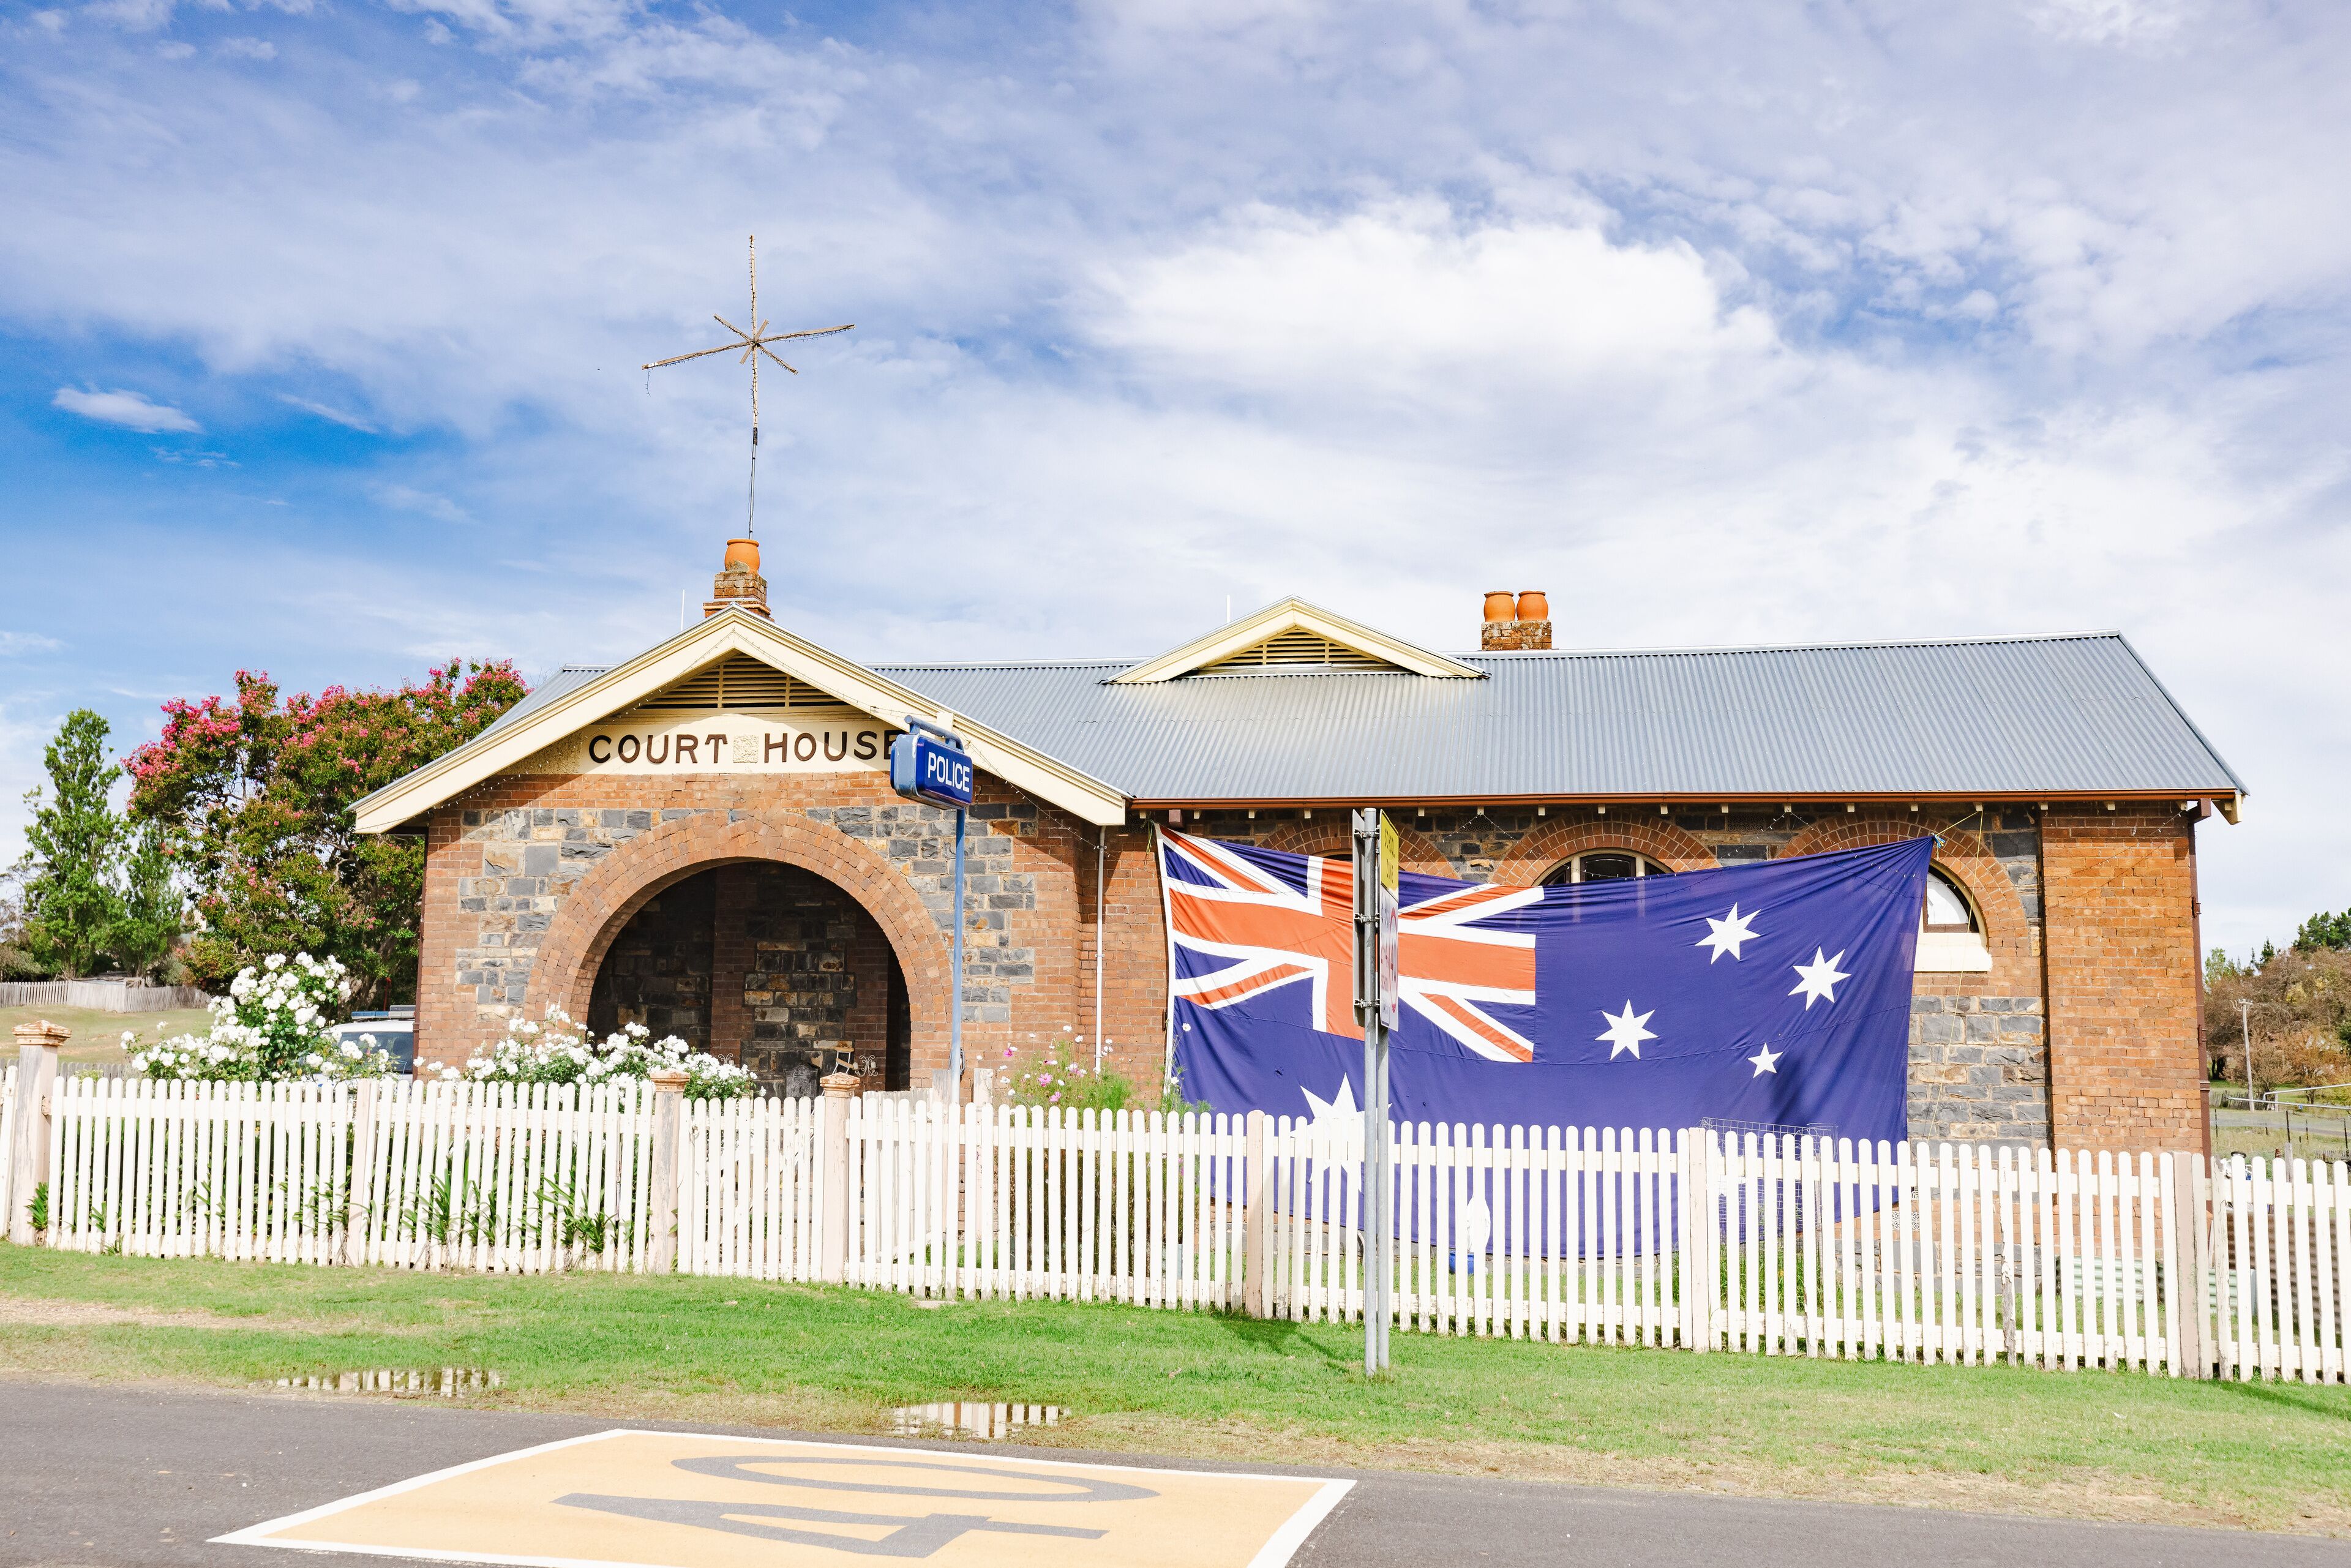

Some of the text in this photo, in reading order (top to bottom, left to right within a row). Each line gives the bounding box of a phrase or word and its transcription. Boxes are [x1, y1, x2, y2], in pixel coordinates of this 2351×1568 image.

[589, 734, 728, 763] COURT
[928, 751, 970, 792] POLICE
[1385, 828, 1395, 858] SCHOOL
[1390, 937, 1397, 983] 40
[549, 1456, 1161, 1558] 40
